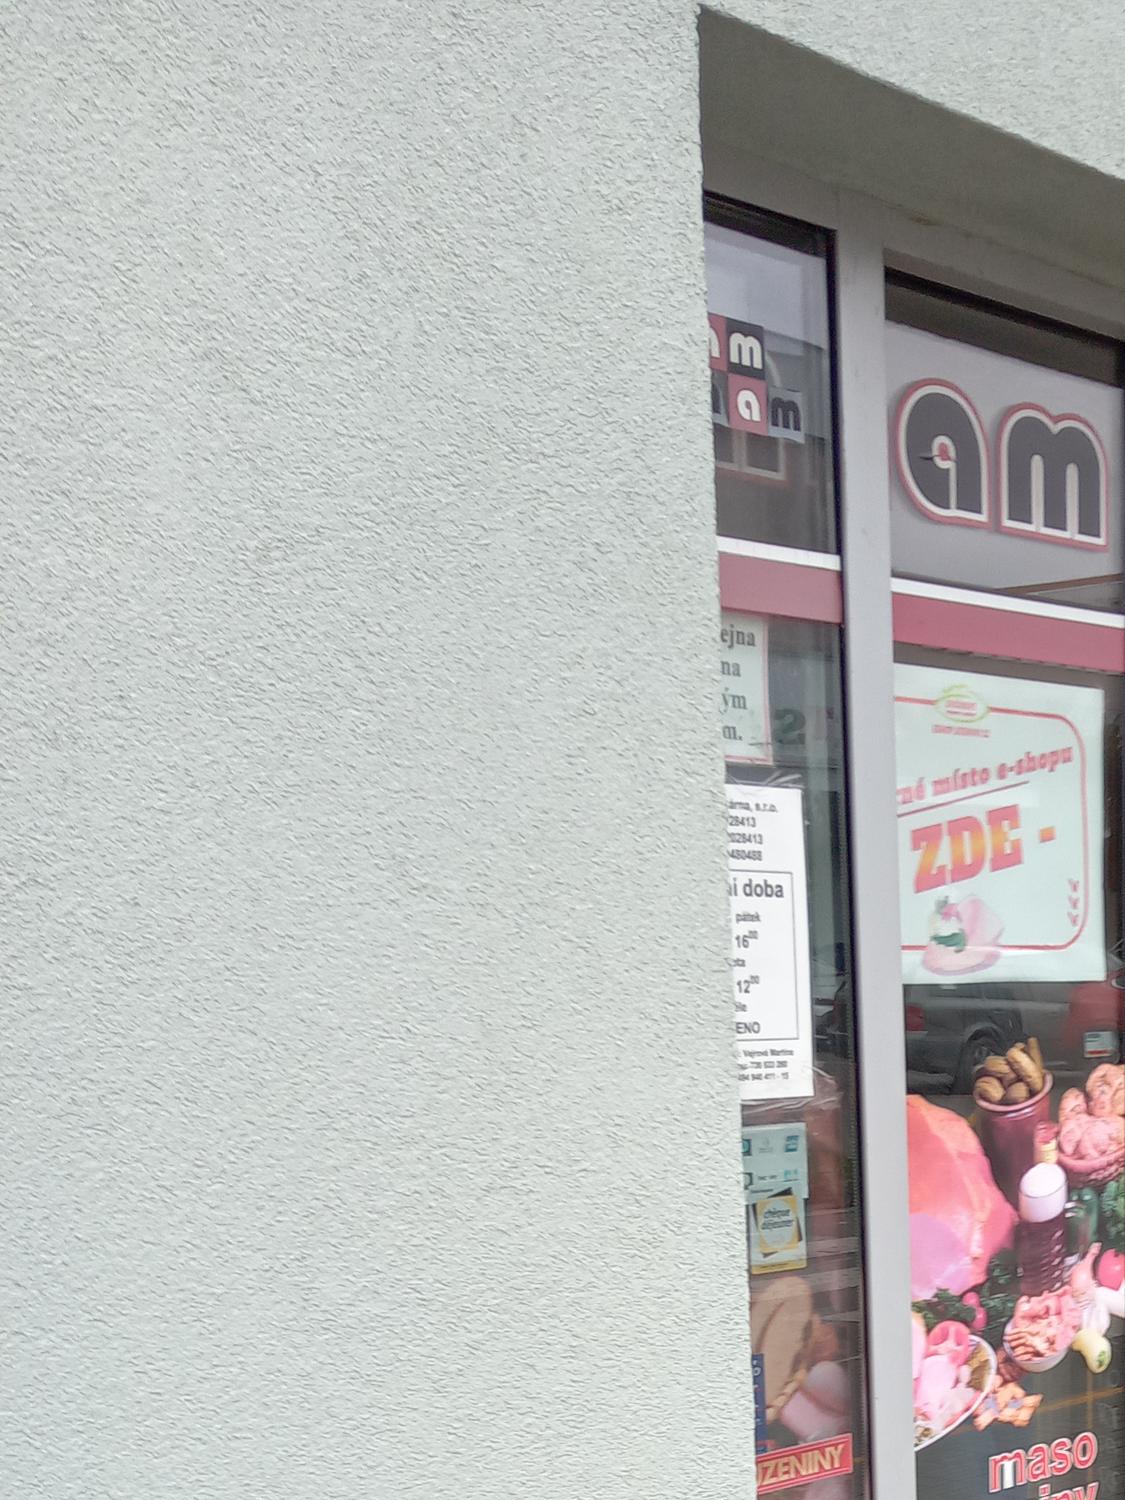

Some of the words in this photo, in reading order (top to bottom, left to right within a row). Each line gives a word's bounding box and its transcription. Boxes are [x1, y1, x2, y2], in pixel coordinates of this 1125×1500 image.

[931, 768, 990, 797] místo
[911, 803, 1024, 894] ZDE
[743, 878, 785, 898] doba
[988, 1431, 1098, 1493] maso
